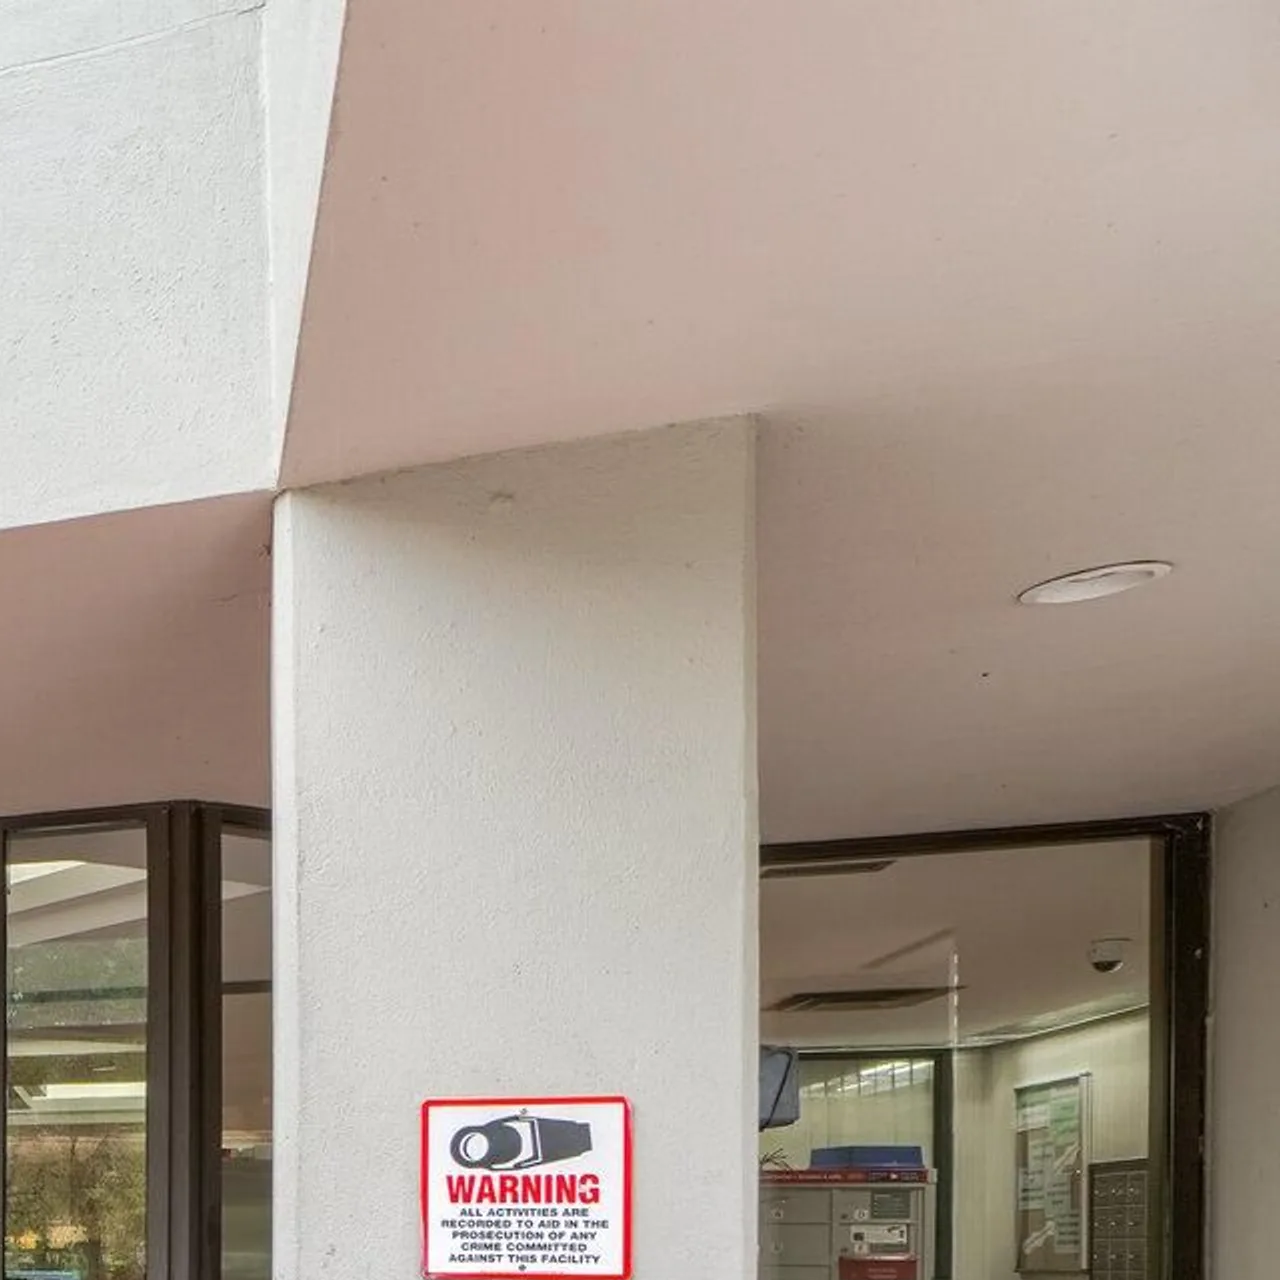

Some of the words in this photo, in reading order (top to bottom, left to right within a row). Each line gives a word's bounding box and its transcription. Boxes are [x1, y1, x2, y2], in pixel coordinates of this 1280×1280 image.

[446, 1174, 600, 1204] WARNING
[460, 1208, 483, 1217] ALL
[487, 1208, 558, 1217] ACTIVITIES
[562, 1208, 589, 1217] ARE
[441, 1220, 512, 1229] RECORDED
[517, 1220, 534, 1229] TO
[538, 1220, 561, 1229] AID
[564, 1220, 578, 1229] IN
[582, 1220, 609, 1229] THE
[452, 1231, 544, 1240] PROSECUTION
[548, 1231, 566, 1240] OF
[570, 1231, 598, 1240] ANY
[460, 1242, 502, 1251] CRIME
[506, 1242, 588, 1252] COMMITTED
[448, 1254, 503, 1263] AGAINST
[508, 1254, 537, 1263] THIS
[541, 1254, 601, 1264] FACILITY
